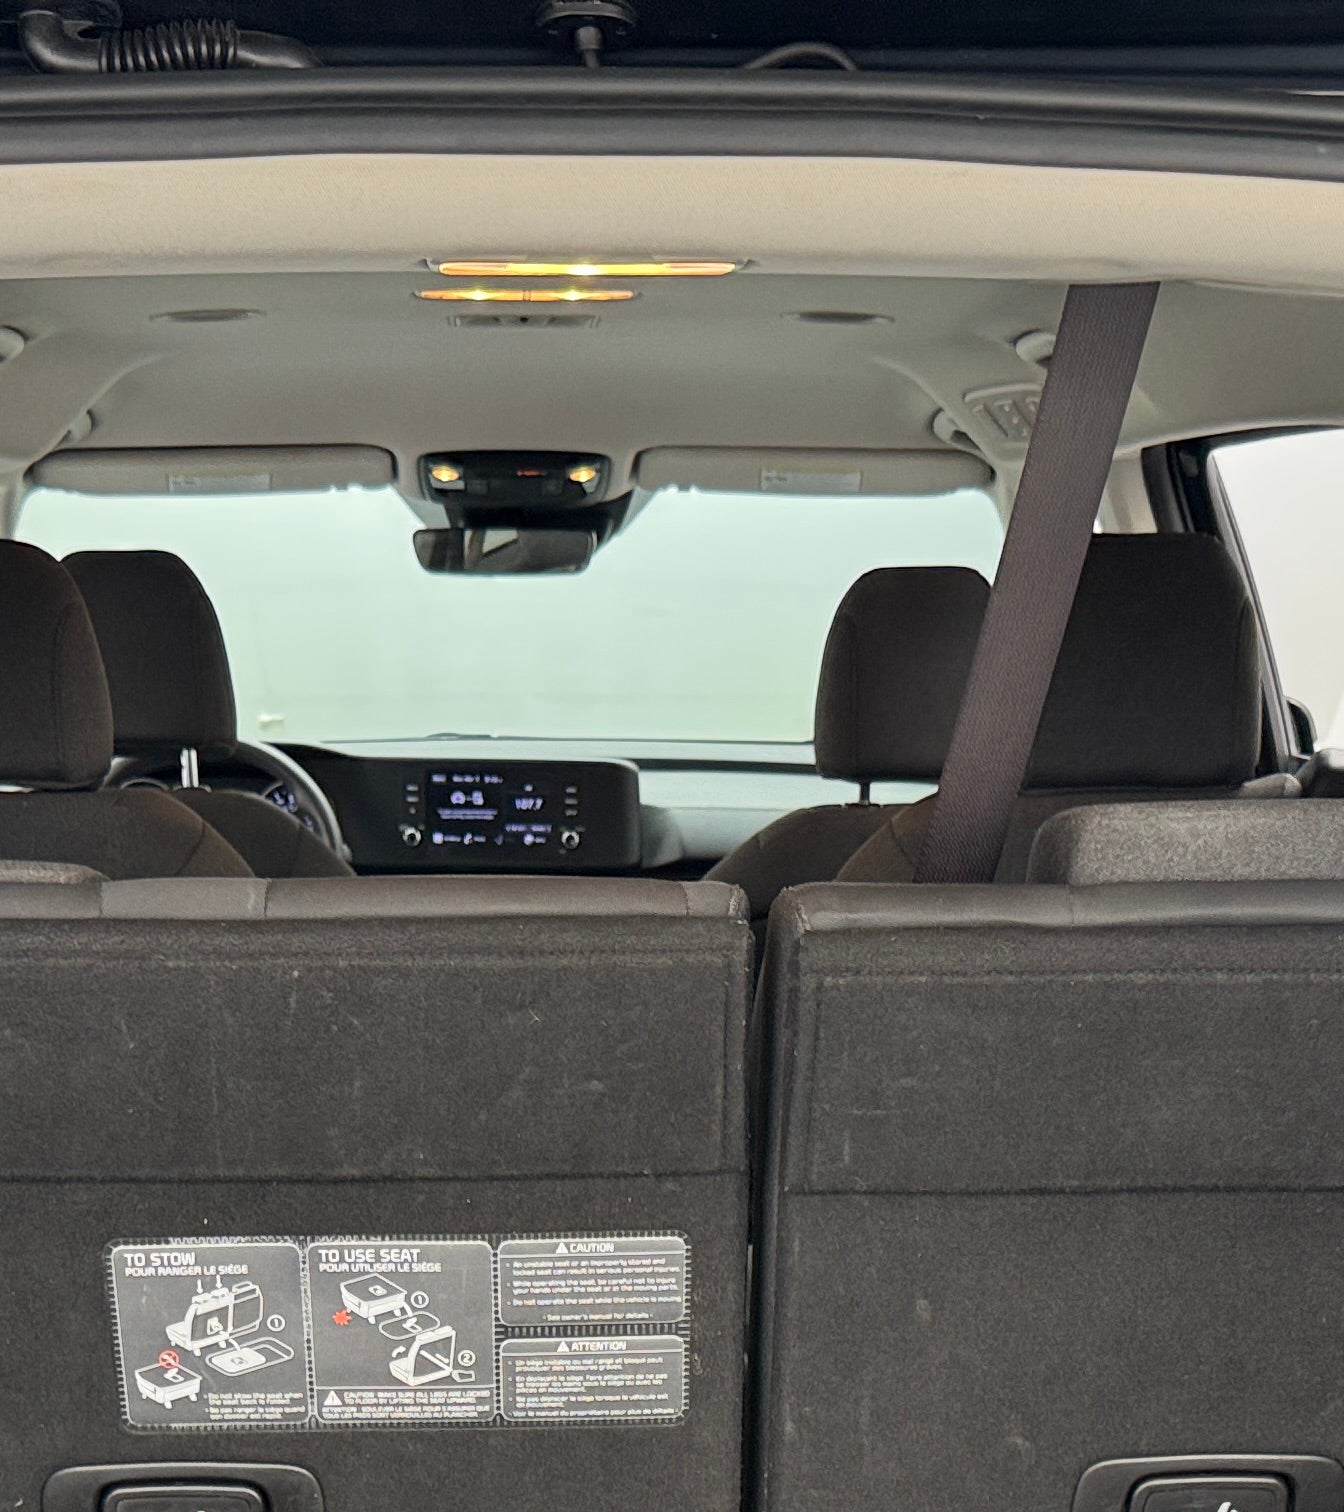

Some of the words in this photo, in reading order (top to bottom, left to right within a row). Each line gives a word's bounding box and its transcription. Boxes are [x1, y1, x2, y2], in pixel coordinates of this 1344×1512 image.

[570, 1242, 614, 1253] CAUTION
[123, 1252, 145, 1266] TO
[150, 1251, 196, 1266] STOW
[318, 1249, 339, 1263] TO
[344, 1248, 375, 1263] USE
[380, 1248, 421, 1263] SEAT
[125, 1267, 156, 1277] POUR
[158, 1266, 201, 1276] RANGER
[204, 1265, 216, 1275] LE
[319, 1263, 349, 1272] POUR
[351, 1263, 395, 1273] UTILISER
[397, 1263, 410, 1272] LE
[571, 1341, 627, 1351] ATTENTION
